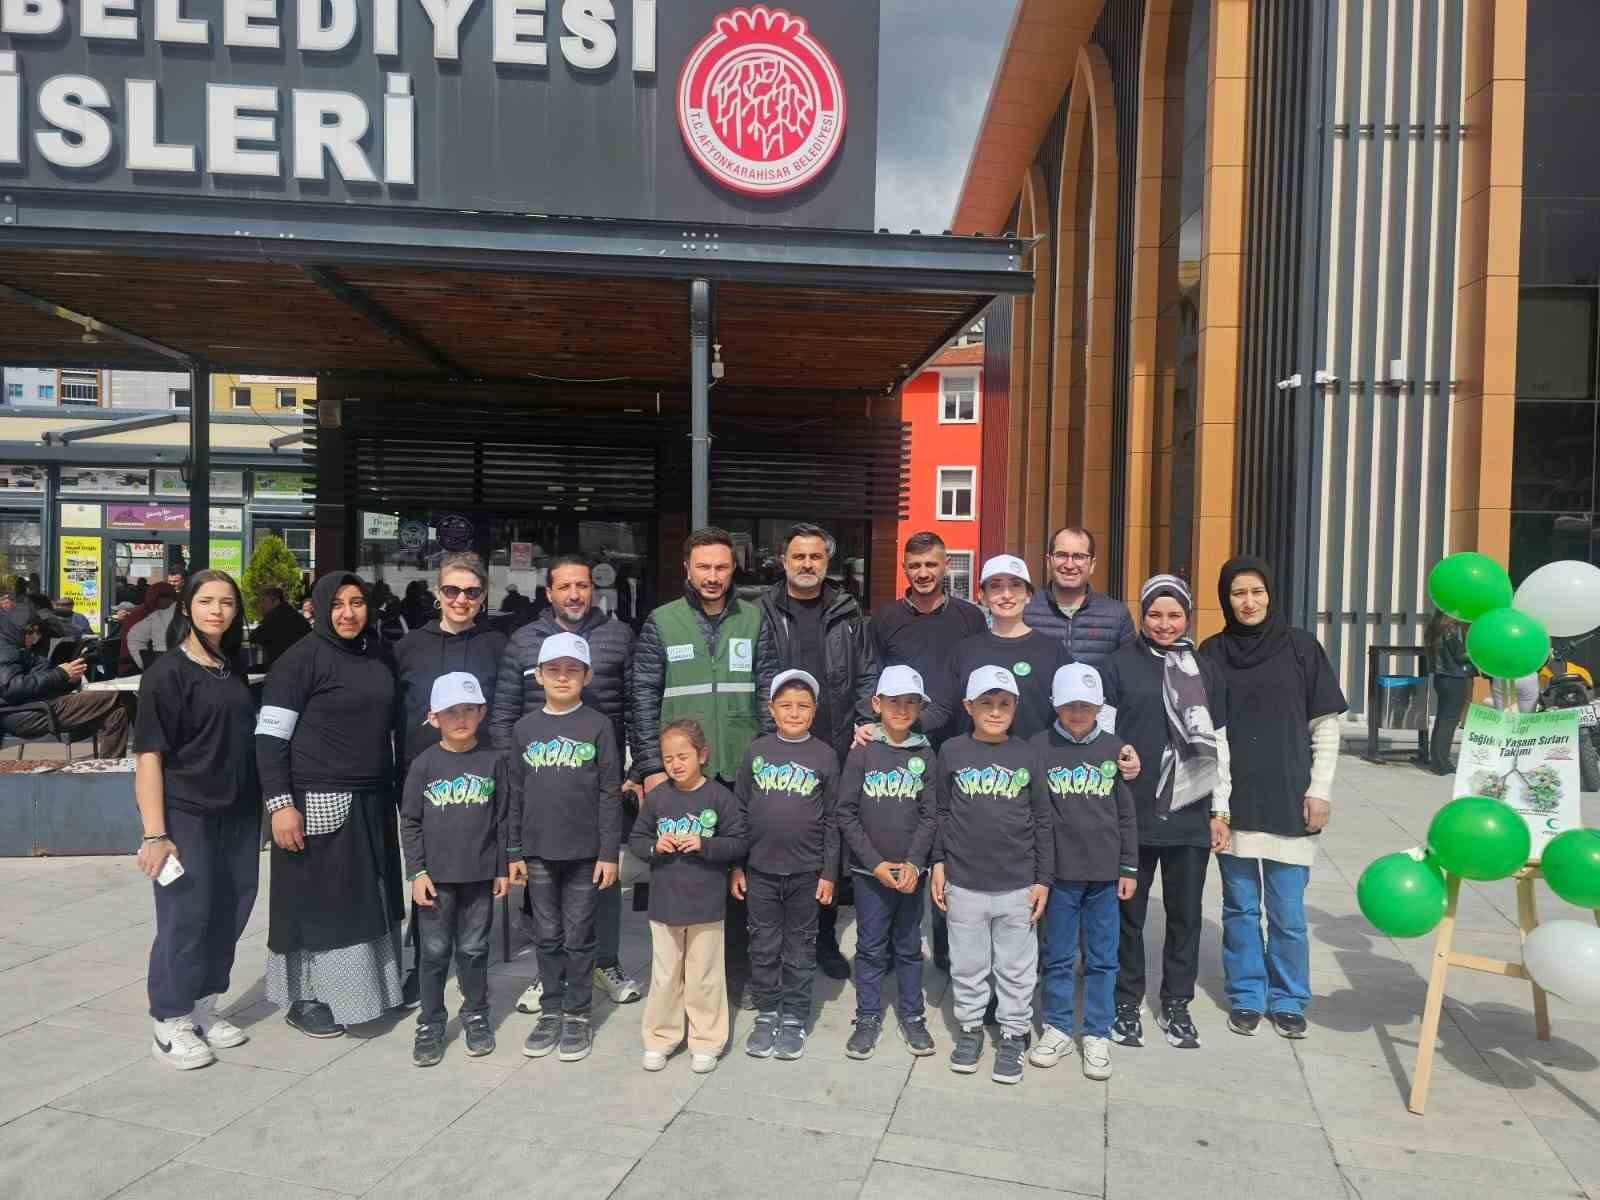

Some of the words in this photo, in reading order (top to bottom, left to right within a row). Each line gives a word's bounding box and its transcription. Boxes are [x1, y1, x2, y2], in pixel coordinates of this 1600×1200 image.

[1505, 737, 1537, 748] Yaşam
[1538, 734, 1570, 745] Sırları
[1500, 747, 1531, 757] Takımı
